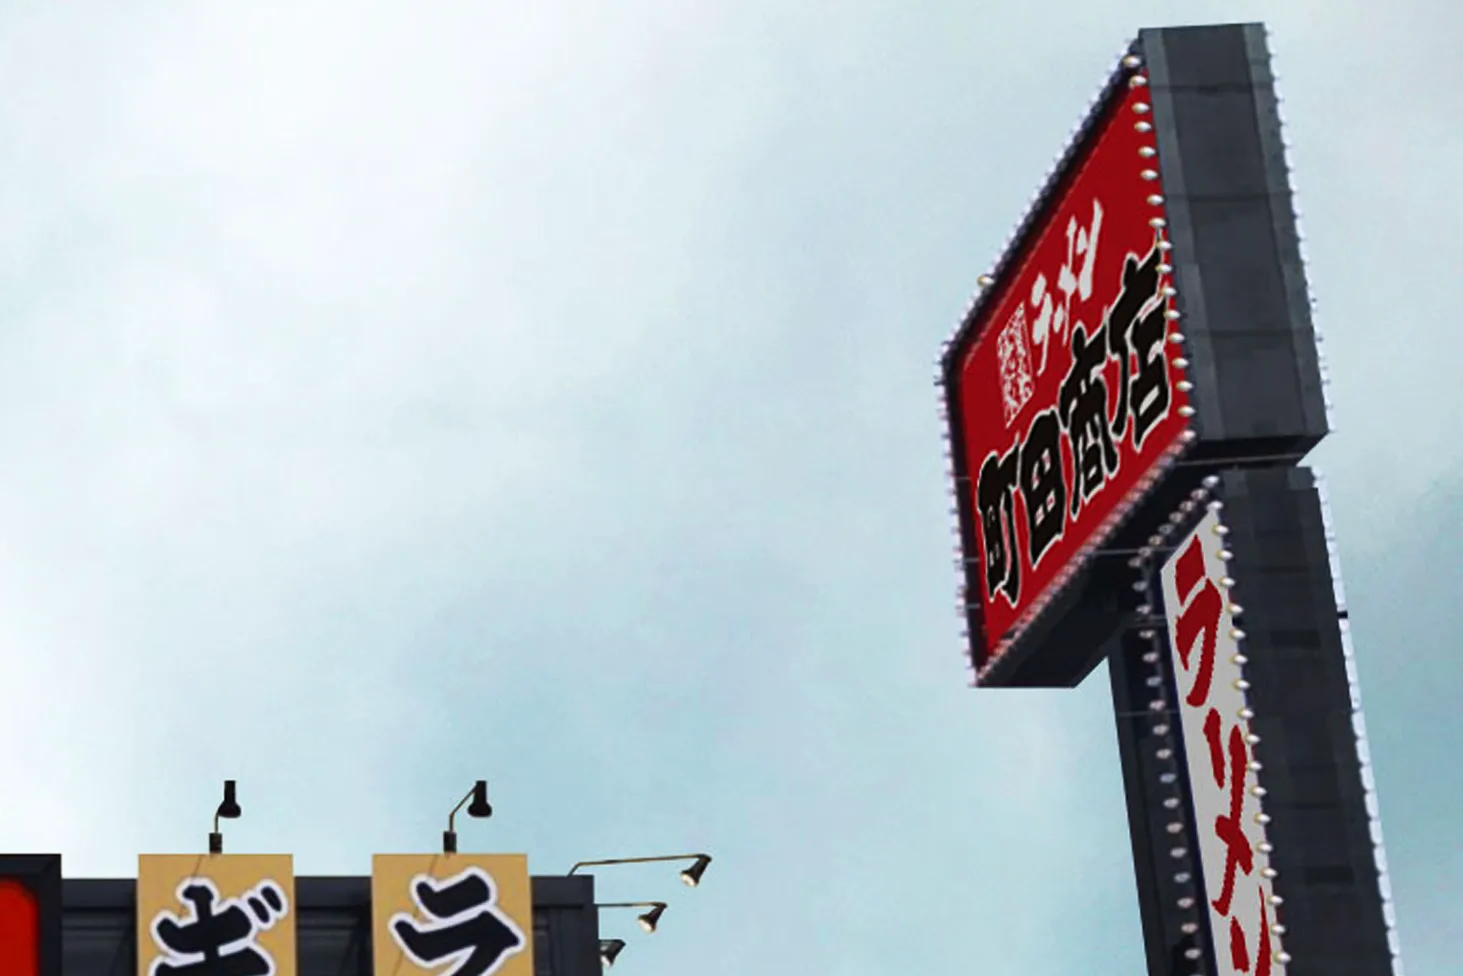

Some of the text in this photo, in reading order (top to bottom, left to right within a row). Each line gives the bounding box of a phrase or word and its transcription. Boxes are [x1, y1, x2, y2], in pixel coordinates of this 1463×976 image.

[977, 226, 1171, 608] 町田商店
[1031, 198, 1103, 376] ラーメン
